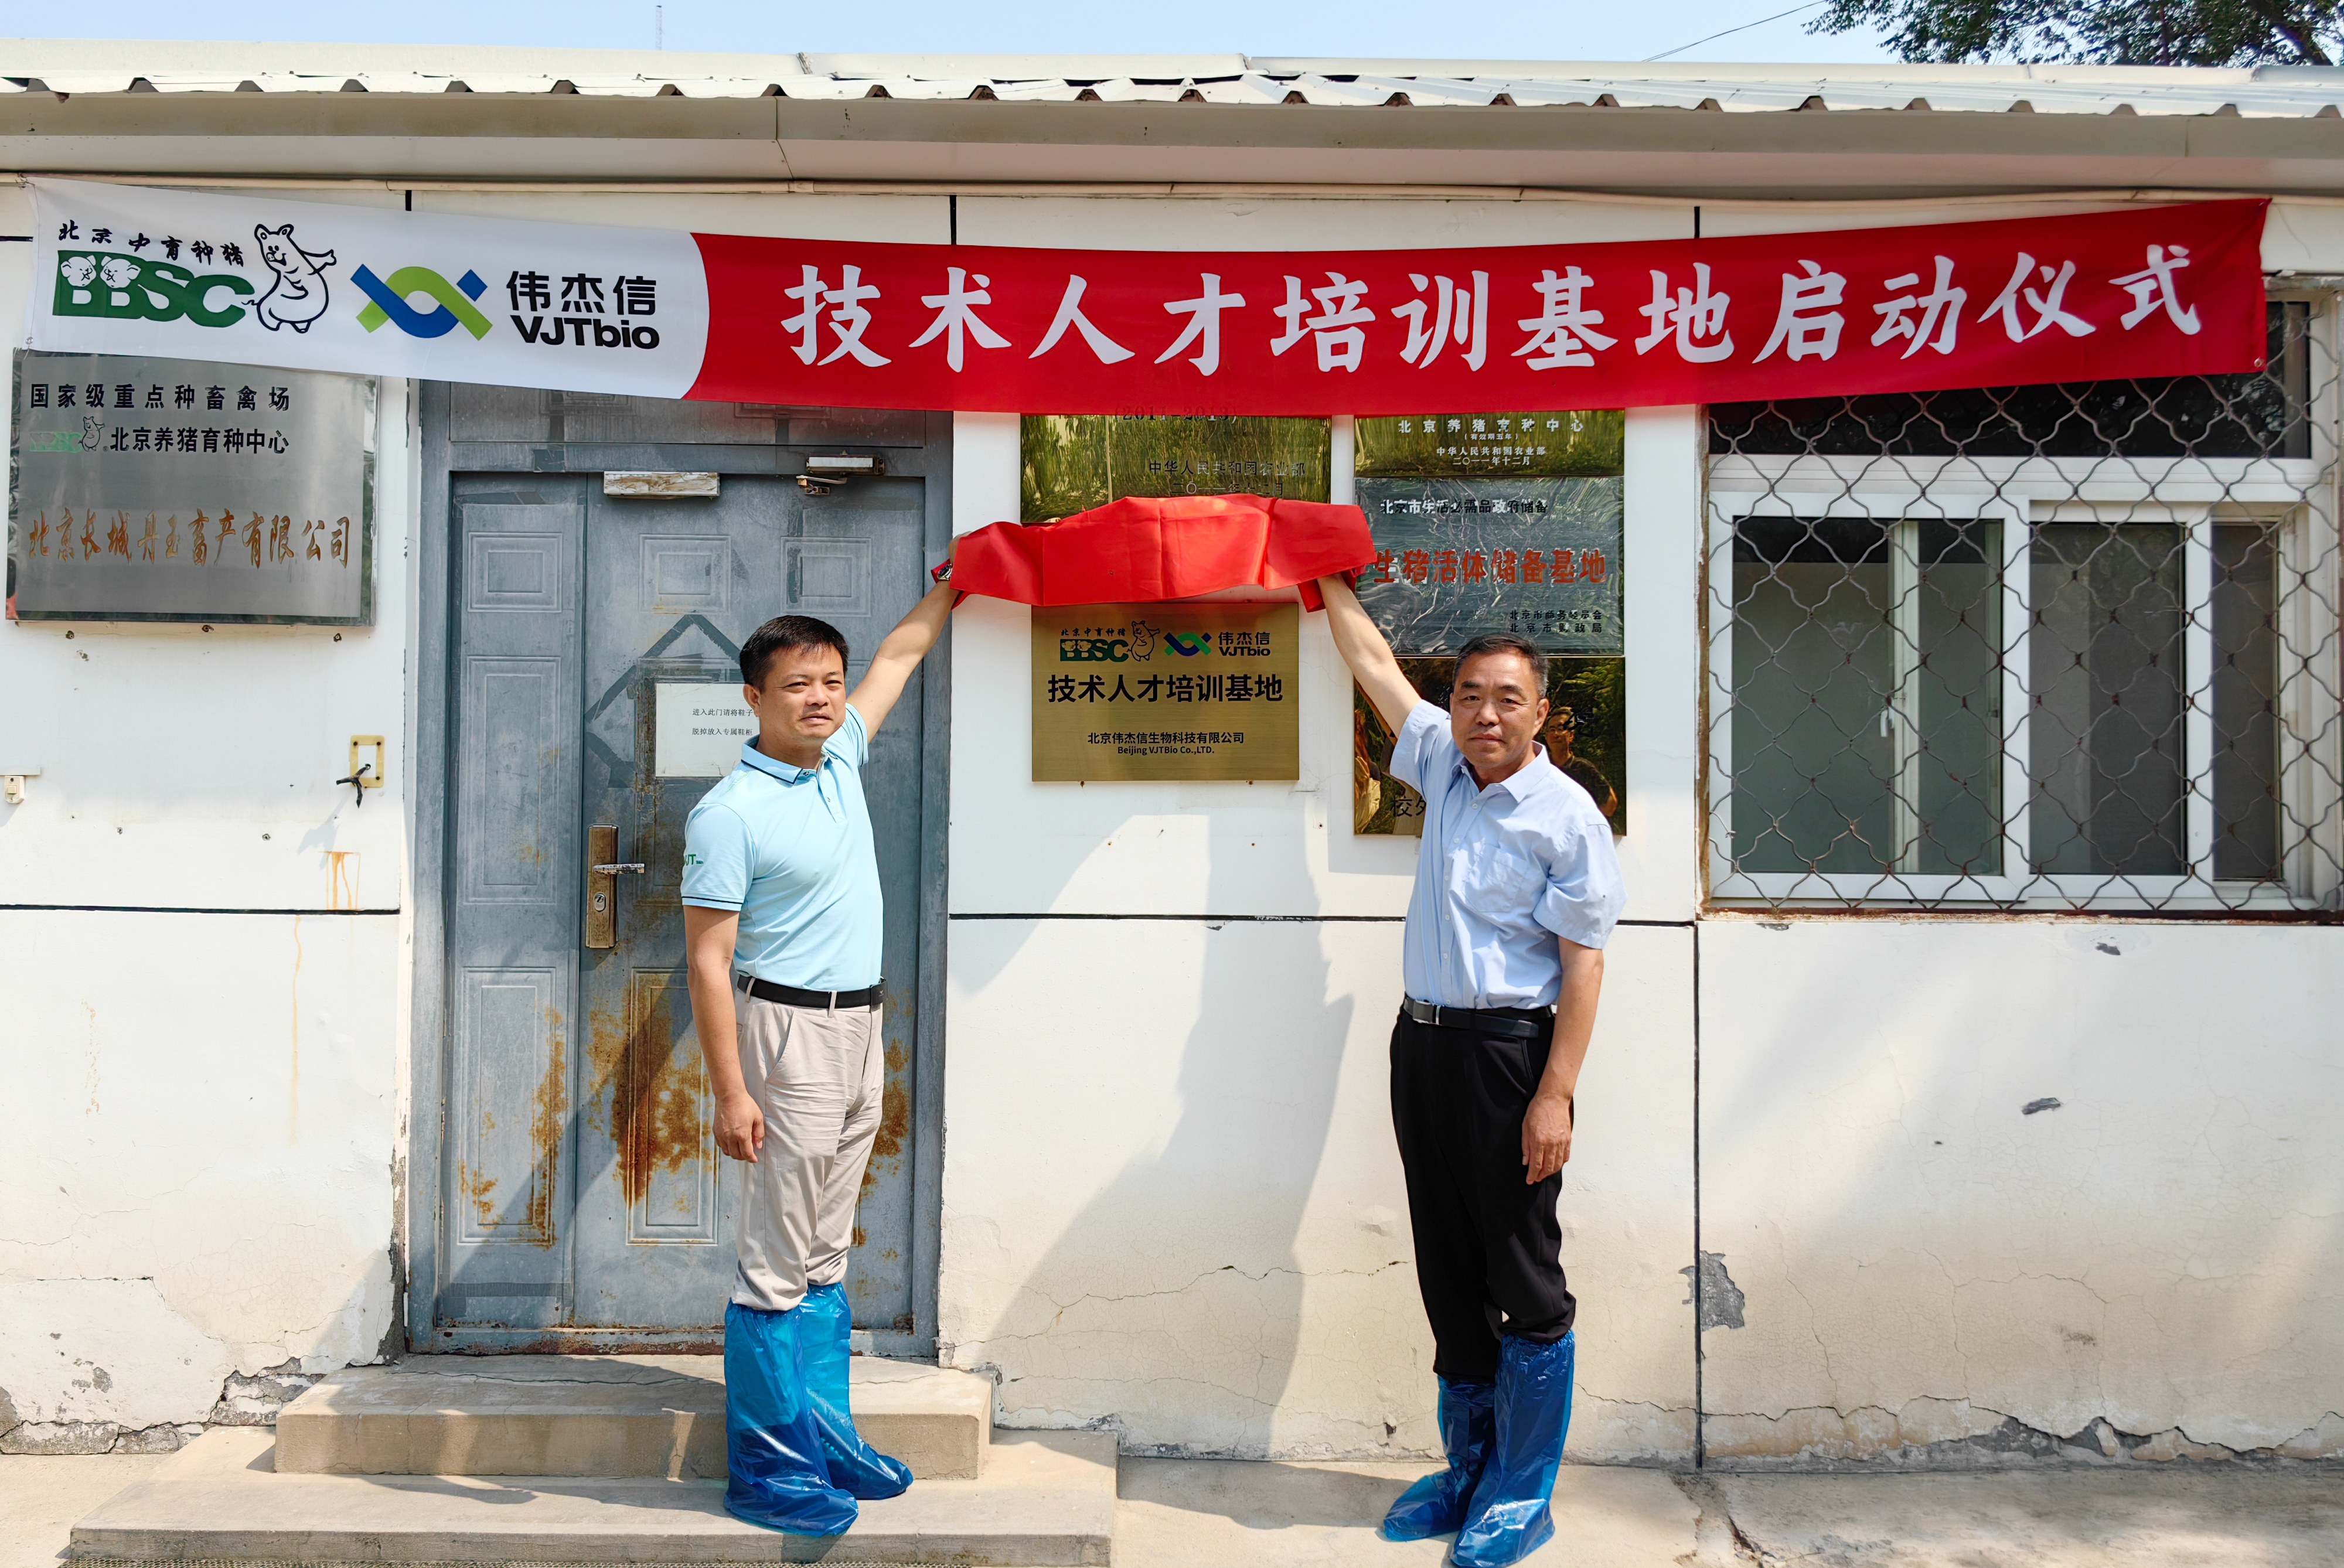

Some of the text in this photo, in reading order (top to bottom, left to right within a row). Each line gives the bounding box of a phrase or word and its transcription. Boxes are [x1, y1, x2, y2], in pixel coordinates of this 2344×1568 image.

[59, 219, 245, 267] 北京中育种猪
[52, 250, 255, 328] BBSC
[506, 271, 657, 315] 伟杰信
[781, 244, 2202, 379] 技术人才培训基地启动仪式
[510, 315, 660, 350] VJTbio
[30, 383, 290, 412] 国家级重点种畜禽场
[1398, 418, 1583, 434] 北京养猪育种中心
[110, 427, 289, 454] 北京养猪育种中心
[1436, 446, 1546, 456] 中华人民共和国农业部
[1149, 461, 1306, 477] 中华人民共和国农业部
[1380, 499, 1548, 514] 北京市生活必需品政府储备
[1374, 548, 1607, 584] 生猪活体储备基地
[1510, 610, 1602, 620] 北京市商务委员会
[1061, 628, 1126, 637] 北京中育种猪
[1510, 623, 1602, 633] 北京市财政局
[1218, 632, 1270, 645] 伟杰信
[1218, 646, 1271, 656] VJTbio
[1048, 674, 1283, 703] 技术人才培训基地
[1088, 732, 1245, 744] 北京伟杰信生物科技有限公司
[1118, 746, 1215, 756] Beijing VJTBio Co.,LTD.
